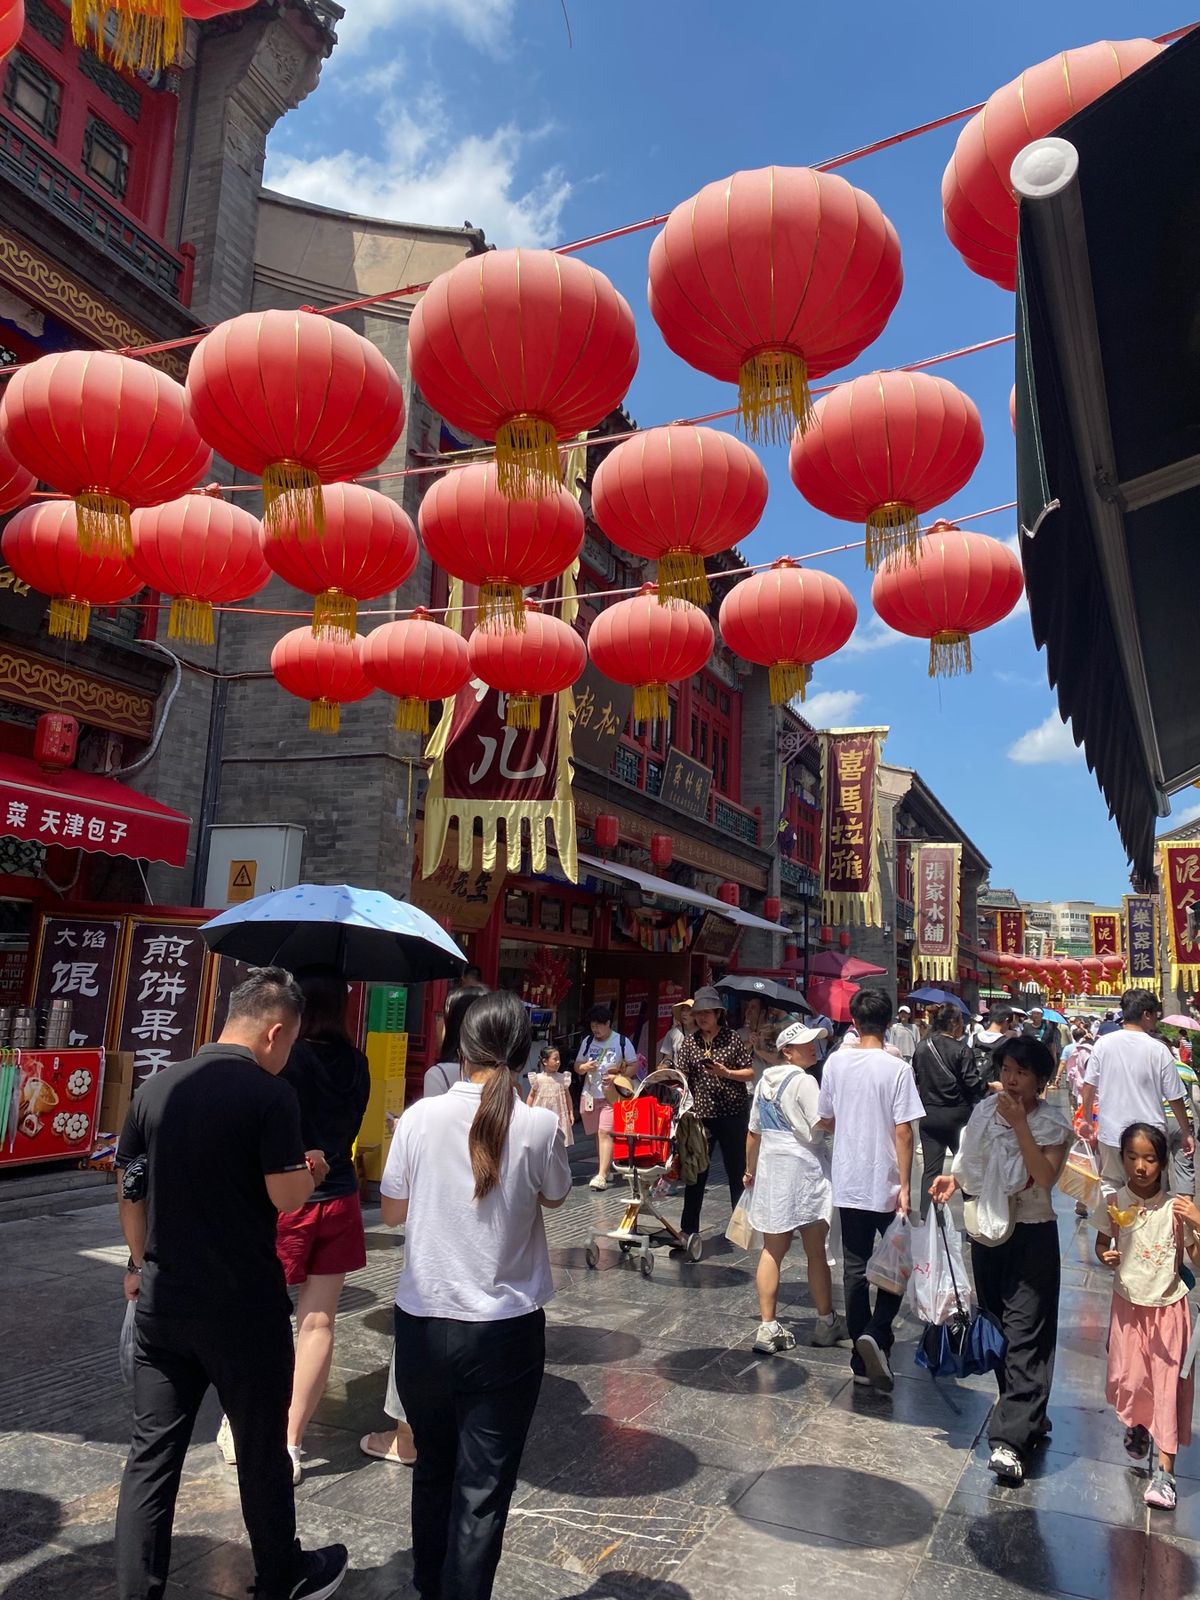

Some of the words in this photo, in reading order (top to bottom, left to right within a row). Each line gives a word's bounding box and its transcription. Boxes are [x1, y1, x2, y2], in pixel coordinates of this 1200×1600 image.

[39, 809, 128, 843] 天津包子
[54, 928, 107, 949] 大馅
[131, 934, 194, 1081] 煎饼果子
